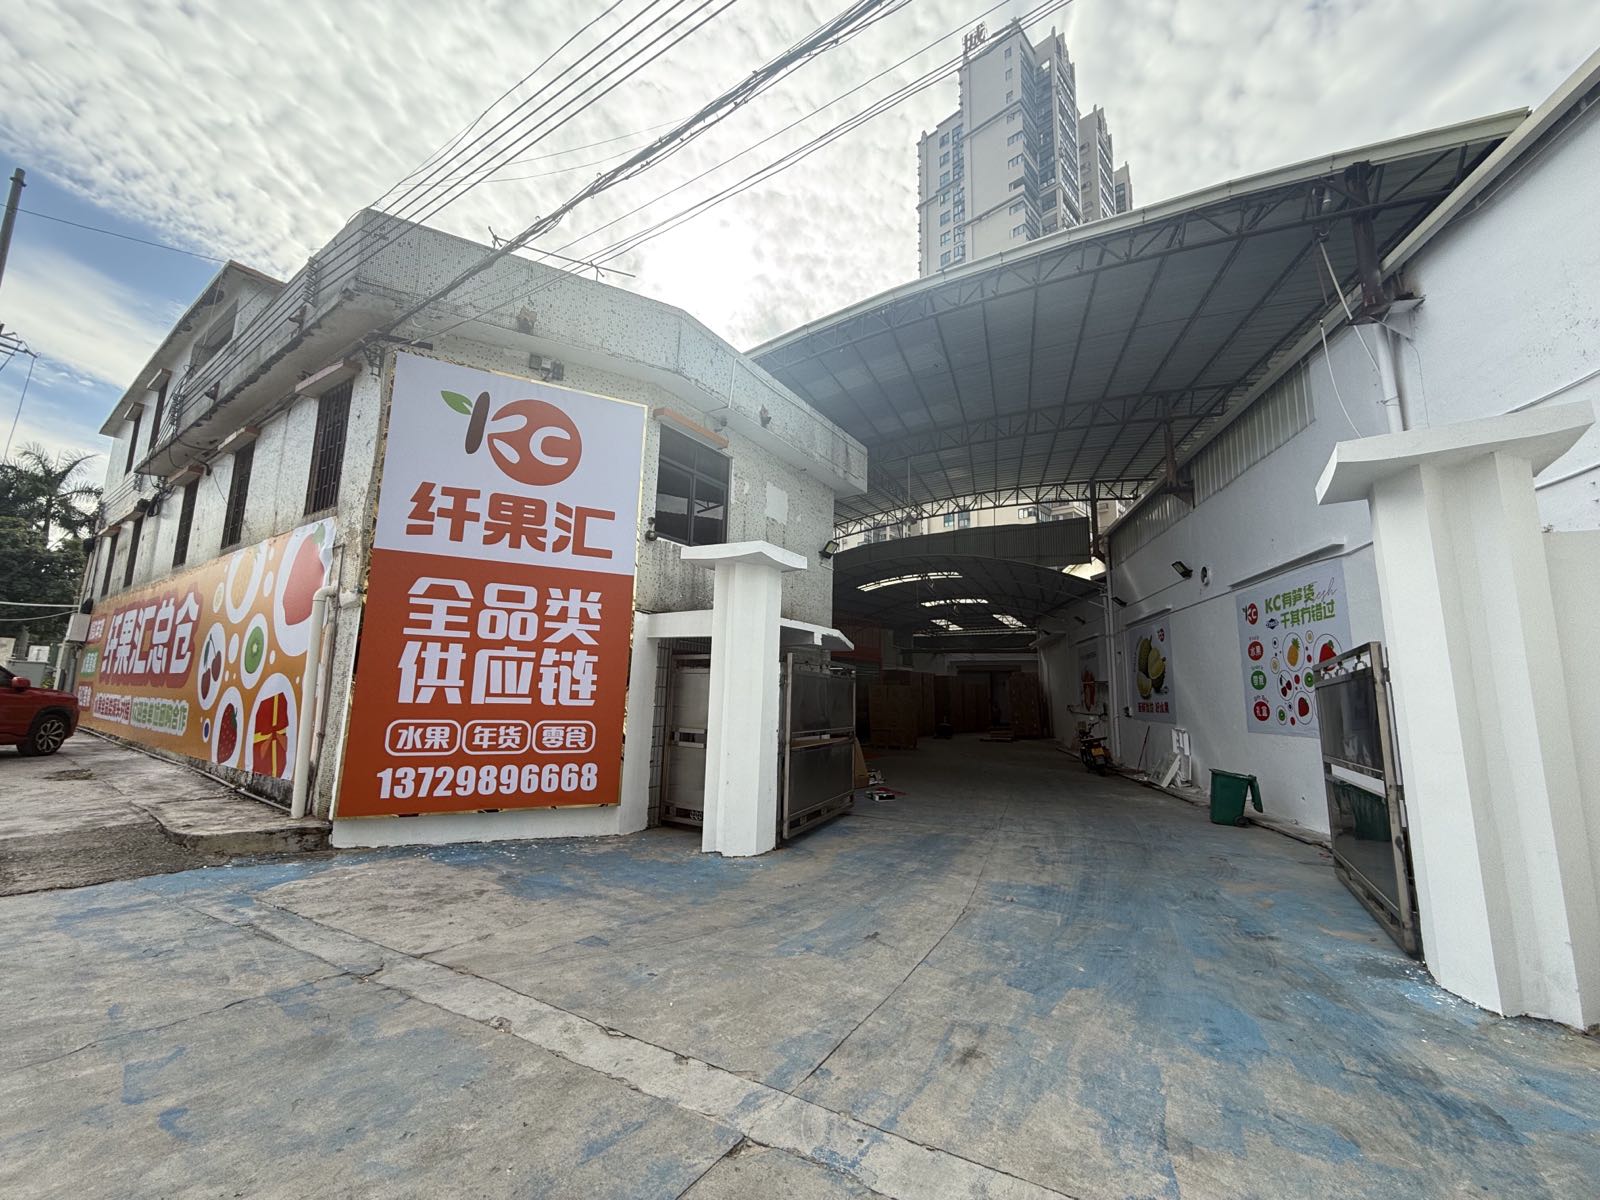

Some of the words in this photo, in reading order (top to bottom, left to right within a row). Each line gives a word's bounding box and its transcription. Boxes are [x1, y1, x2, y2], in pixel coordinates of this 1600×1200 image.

[406, 482, 616, 560] 纤果汇
[101, 592, 199, 675] 纤果汇总仓
[403, 576, 602, 646] 全品类
[398, 641, 599, 707] 供应链
[396, 726, 451, 750] 水果
[472, 725, 522, 750] 年货
[541, 725, 588, 749] 零食
[376, 762, 598, 799] 13729896668
